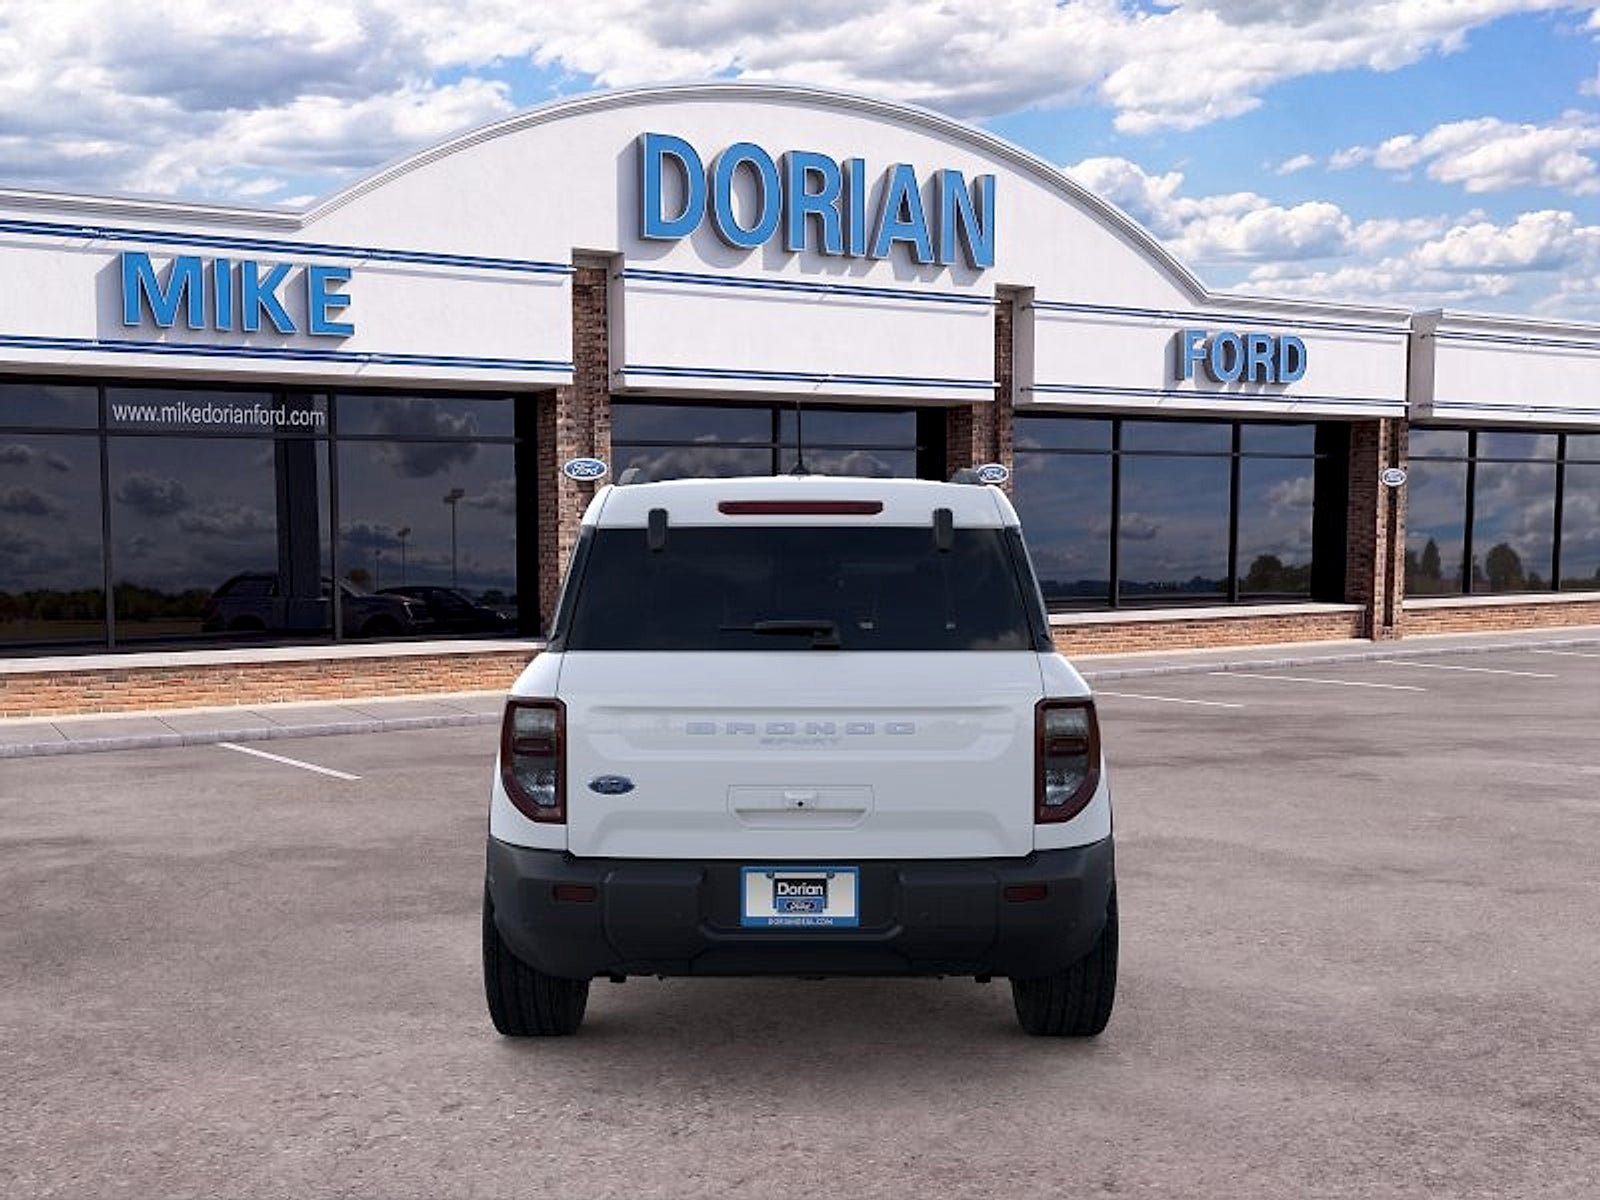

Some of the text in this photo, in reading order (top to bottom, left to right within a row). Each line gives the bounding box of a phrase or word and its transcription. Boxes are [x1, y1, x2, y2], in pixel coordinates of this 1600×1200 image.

[640, 132, 996, 270] DORIAN
[121, 251, 355, 336] MIKE
[1179, 328, 1308, 384] FORD
[112, 401, 325, 426] www.mikedorianford.com
[685, 721, 916, 736] BRONCO
[777, 881, 824, 896] Dorian
